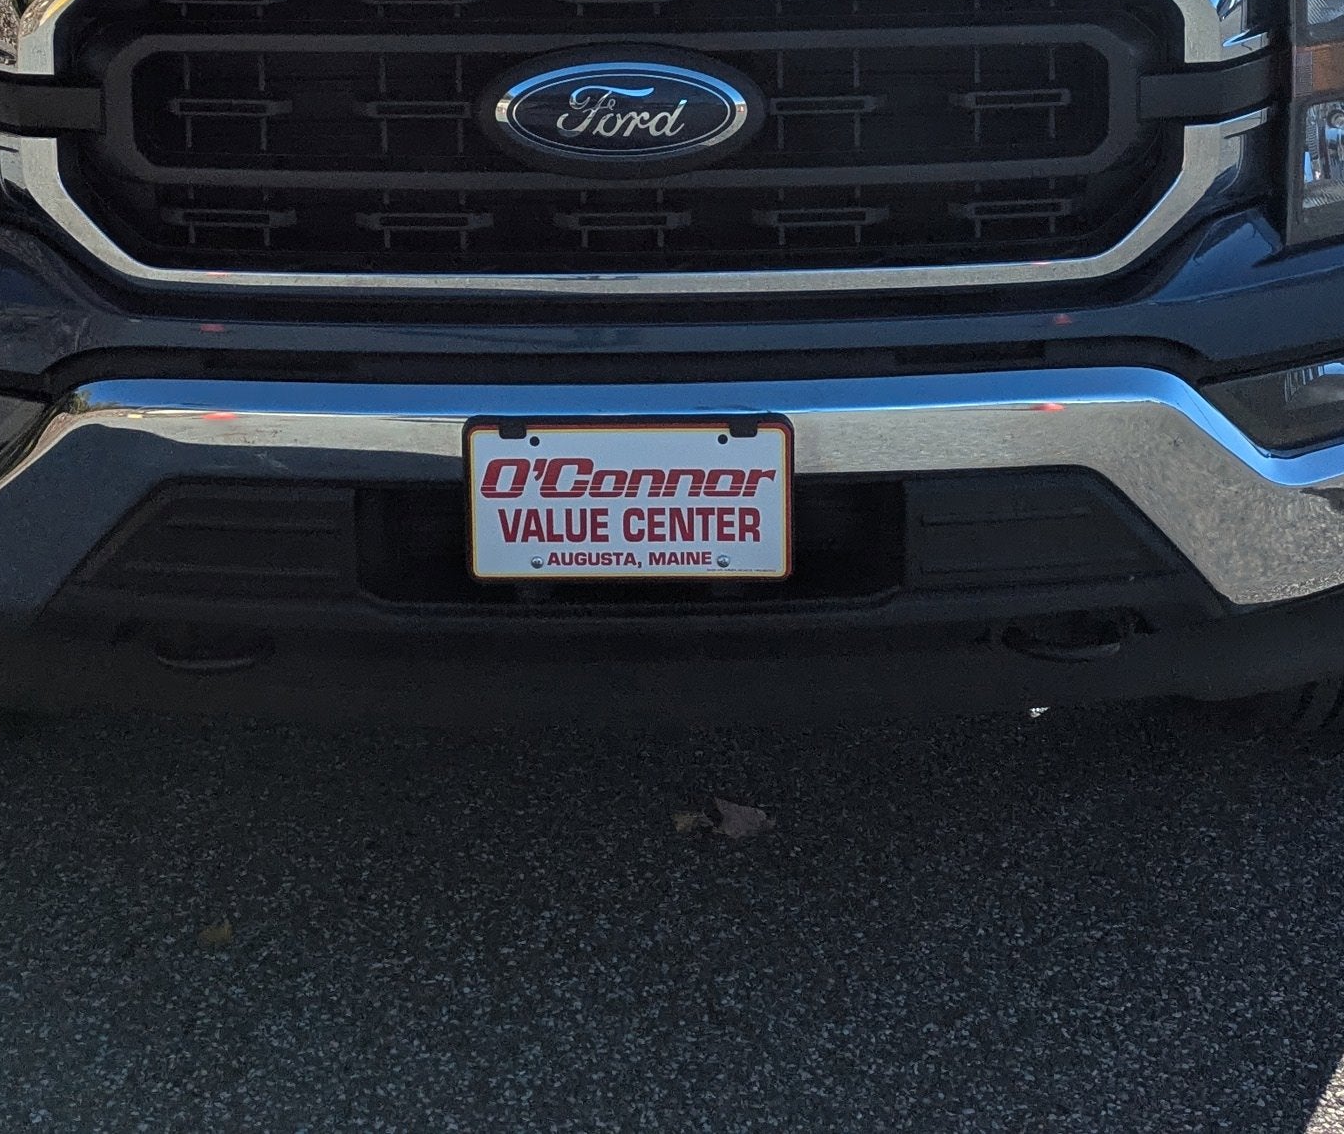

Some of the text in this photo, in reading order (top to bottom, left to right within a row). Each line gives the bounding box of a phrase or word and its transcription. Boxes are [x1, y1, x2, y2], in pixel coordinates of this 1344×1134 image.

[556, 85, 688, 138] Ford
[480, 458, 776, 498] O'Connor
[498, 507, 761, 543] VALUE CENTER
[547, 551, 712, 568] AUGUSTA, MAINE
